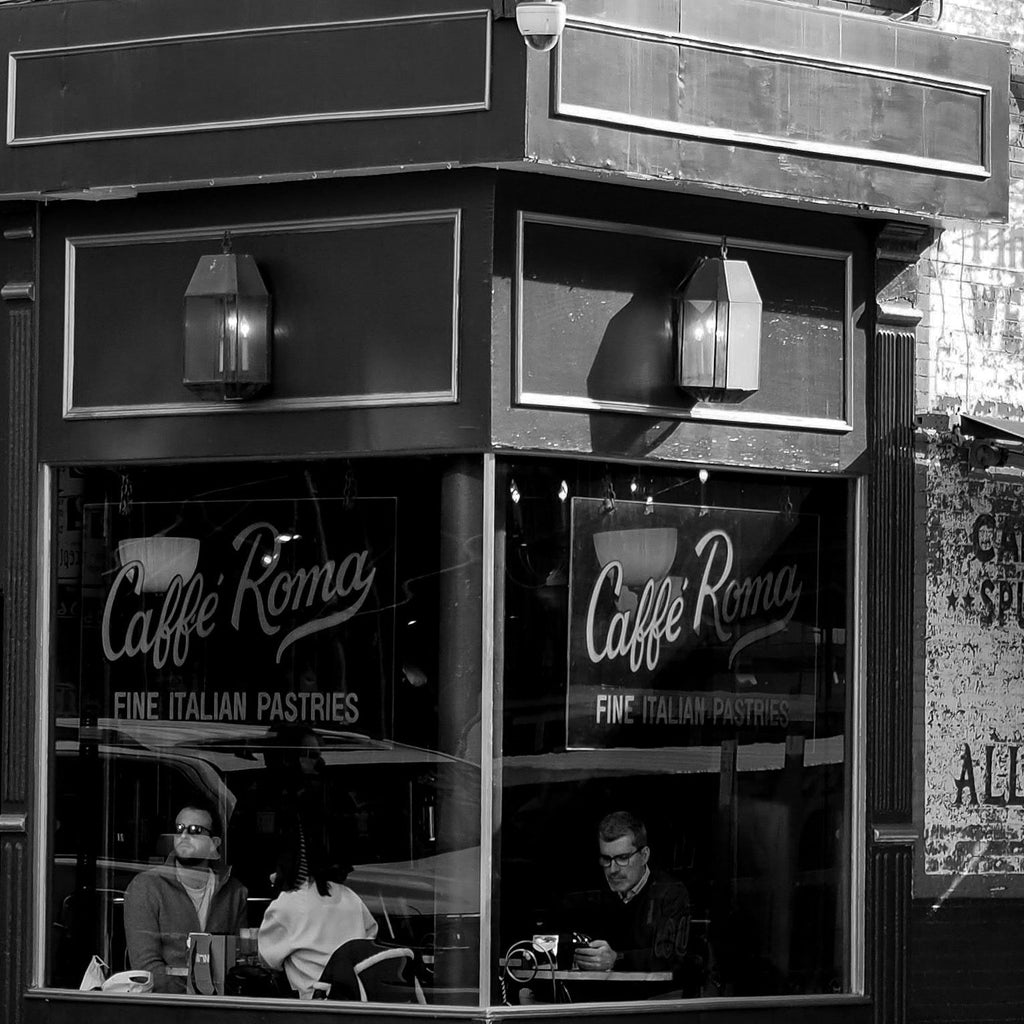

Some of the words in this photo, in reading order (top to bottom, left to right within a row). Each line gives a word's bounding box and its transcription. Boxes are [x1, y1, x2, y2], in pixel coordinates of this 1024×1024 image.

[101, 559, 224, 669] Caffé
[231, 522, 376, 664] Roma
[586, 560, 688, 673] Caffé
[693, 529, 802, 670] Roma
[114, 691, 159, 720] FINE
[169, 691, 247, 721] ITALIAN
[257, 692, 360, 724] PASTRIES
[596, 694, 635, 724] FINE
[642, 694, 705, 726] ITALIAN
[713, 697, 790, 727] PASTRIES
